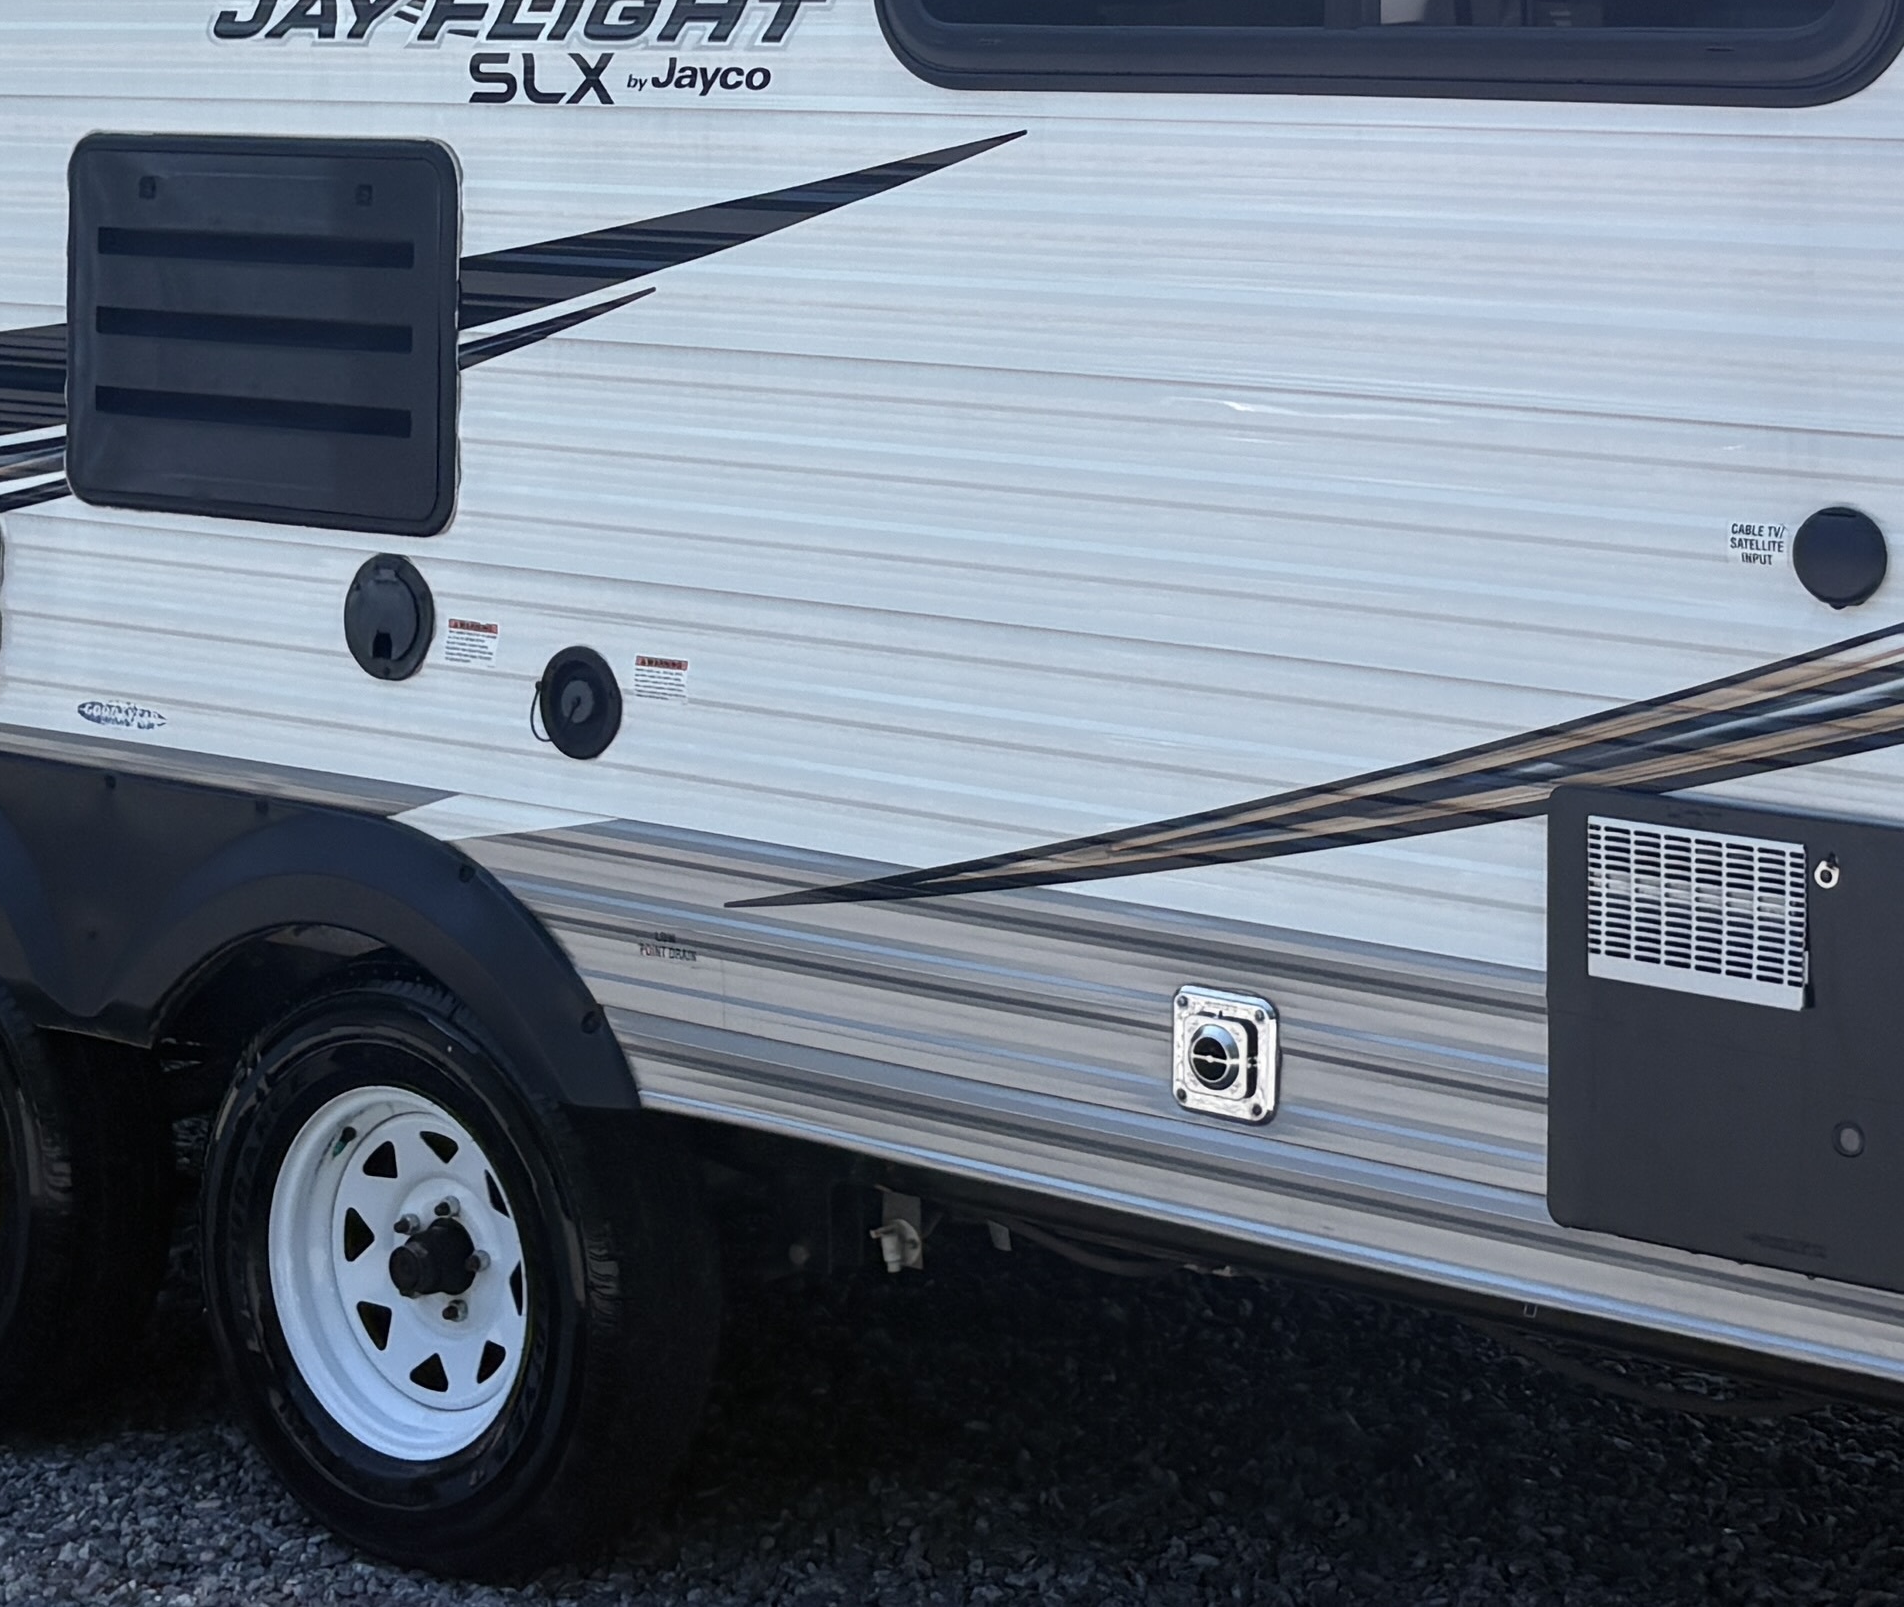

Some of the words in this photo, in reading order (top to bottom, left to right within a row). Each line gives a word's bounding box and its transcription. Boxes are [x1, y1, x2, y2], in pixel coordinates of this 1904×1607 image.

[468, 52, 617, 106] SLX
[626, 74, 649, 93] by
[650, 57, 773, 97] Jayco
[1731, 523, 1765, 537] CABLE
[1730, 537, 1785, 553] SATELLITE
[1741, 552, 1773, 565] INPUT
